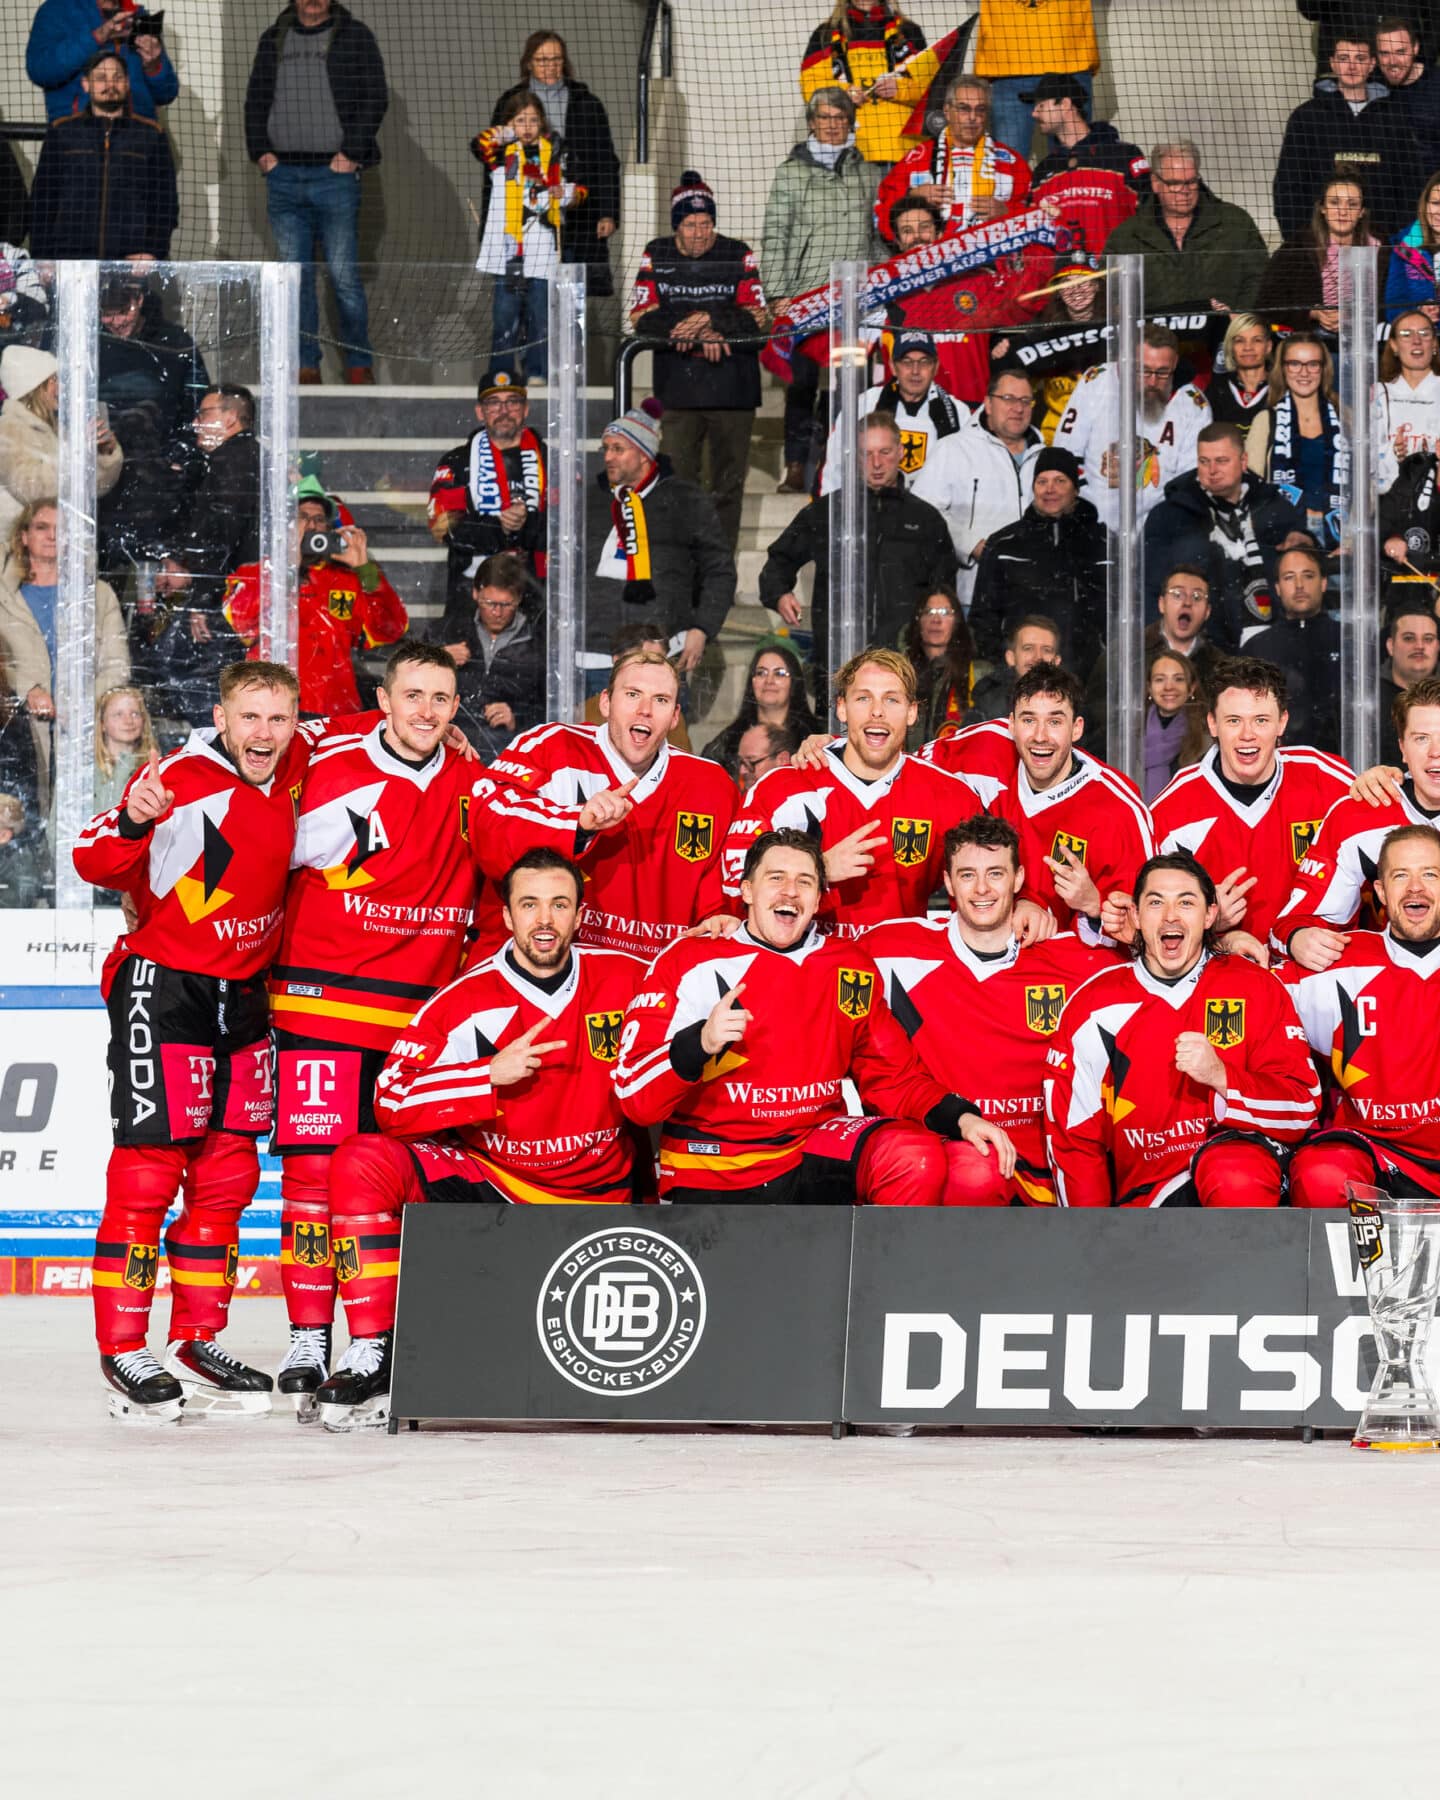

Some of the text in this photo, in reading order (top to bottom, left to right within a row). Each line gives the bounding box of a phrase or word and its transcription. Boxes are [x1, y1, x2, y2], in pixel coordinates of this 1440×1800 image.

[367, 811, 390, 851] A
[1356, 996, 1377, 1036] C
[726, 1078, 842, 1104] WESTMINST
[289, 1113, 342, 1125] MAGENTA
[296, 1125, 333, 1136] SPORT
[564, 1237, 685, 1278] DEUTSCHER
[546, 1316, 694, 1386] EISHOCKEY-BUND
